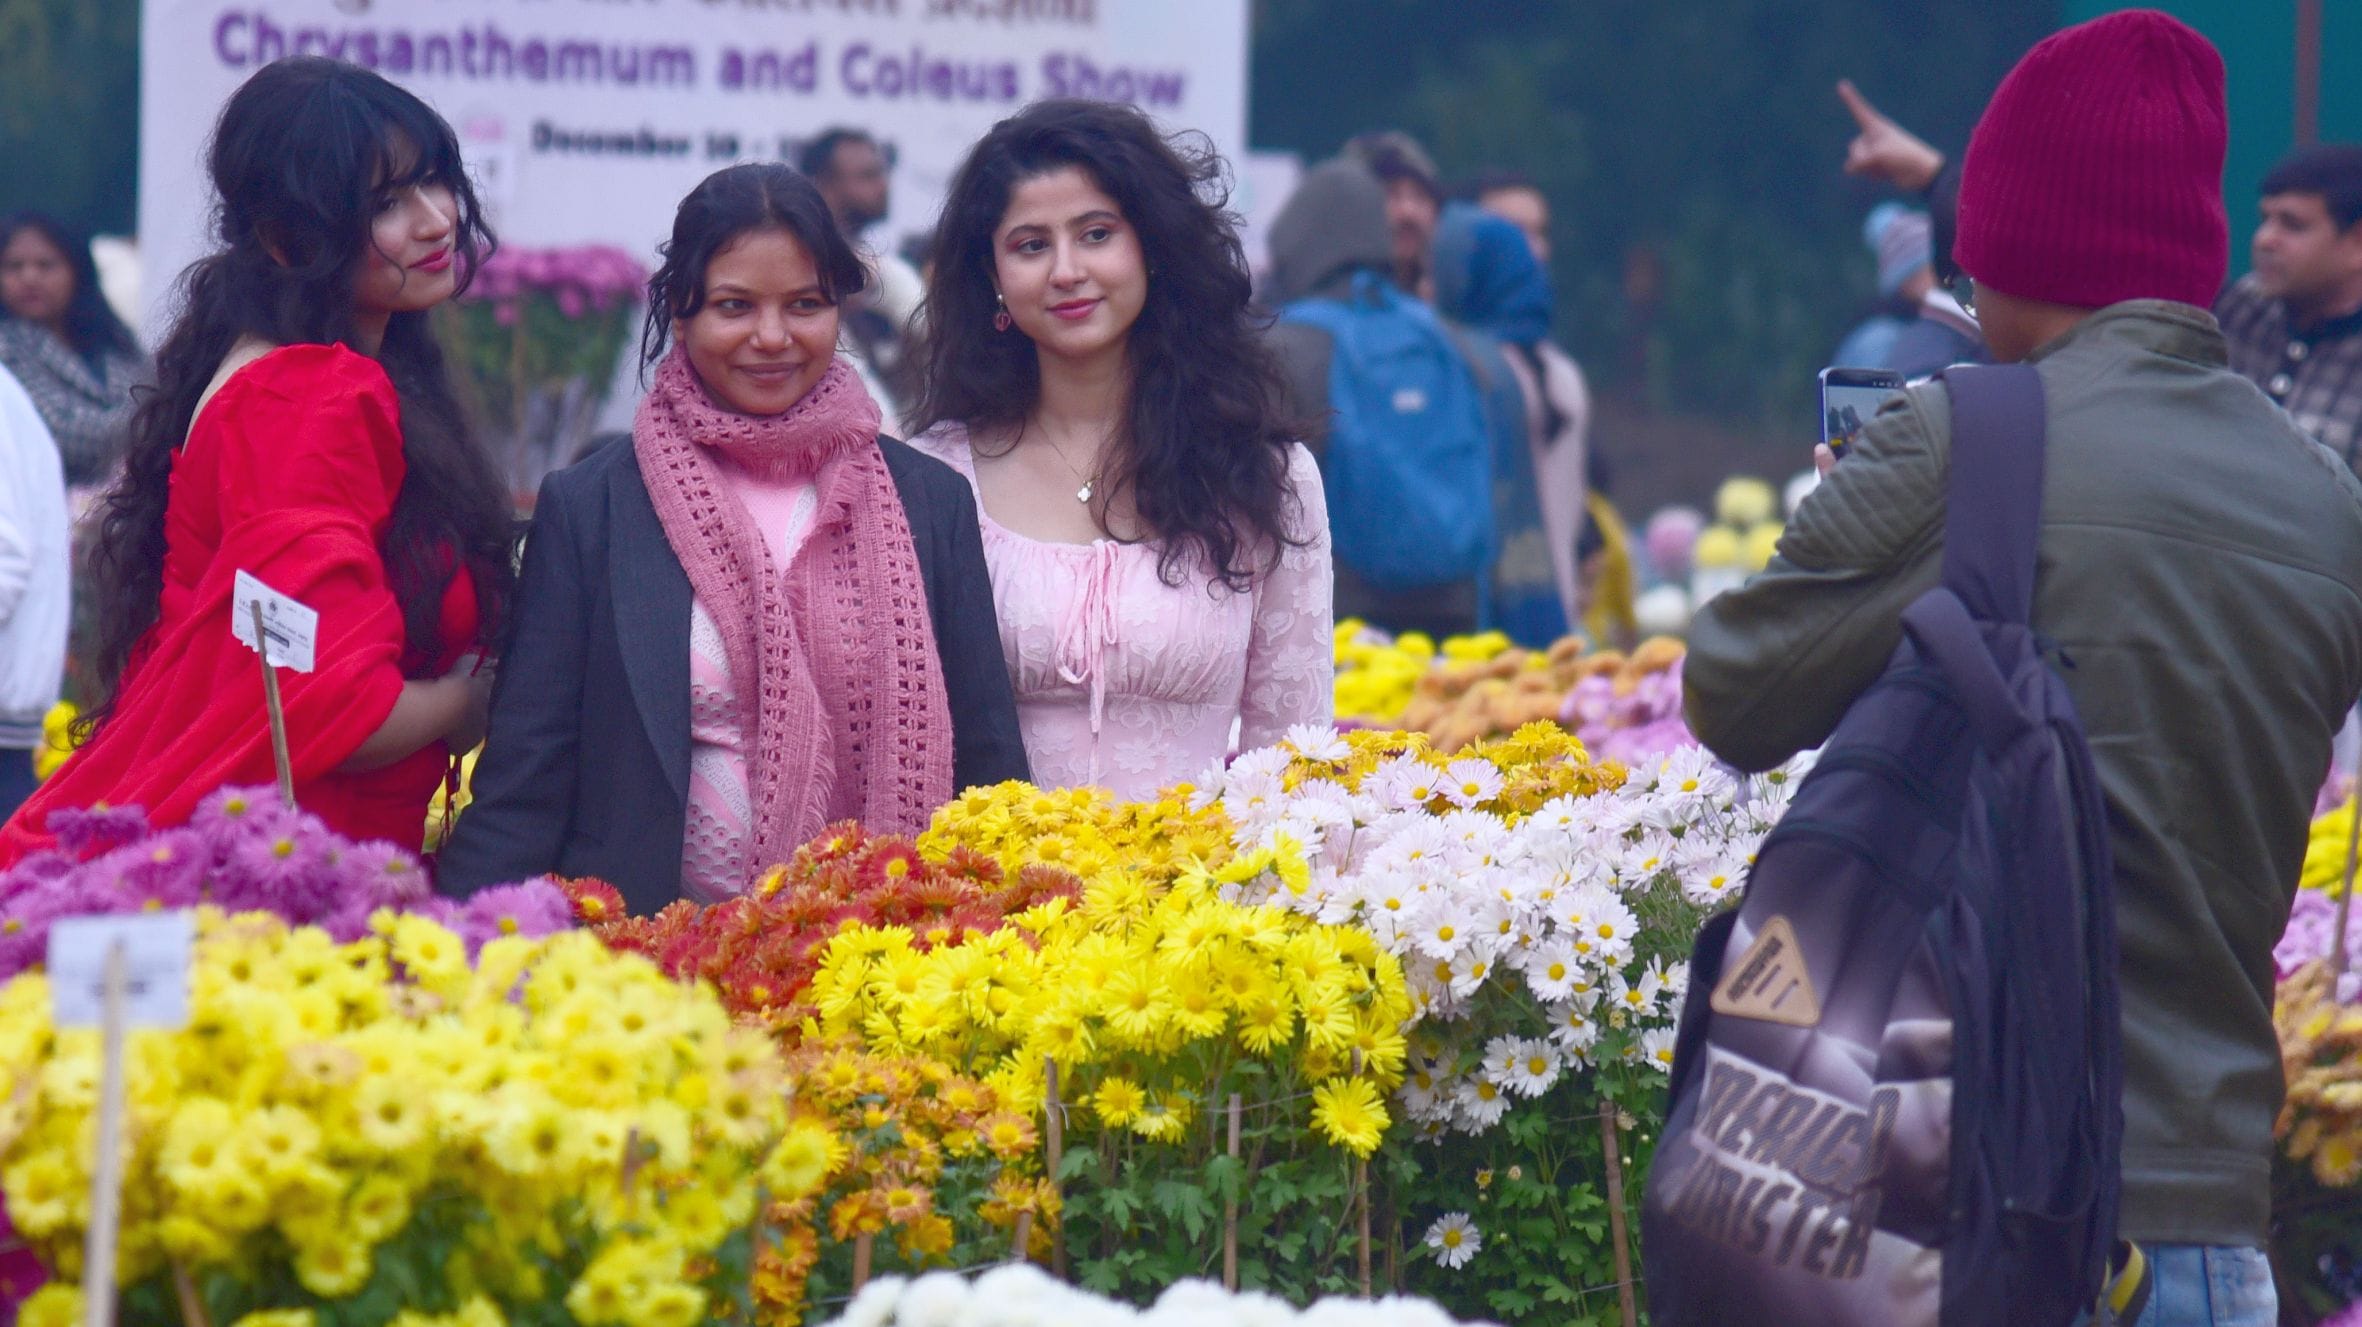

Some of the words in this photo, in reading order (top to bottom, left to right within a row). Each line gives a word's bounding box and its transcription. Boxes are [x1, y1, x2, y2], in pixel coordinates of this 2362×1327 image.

[213, 8, 697, 86] Chrysanthemum
[719, 42, 819, 92] and
[840, 43, 1018, 101] Coleus
[1041, 52, 1188, 108] Show
[531, 119, 691, 156] December
